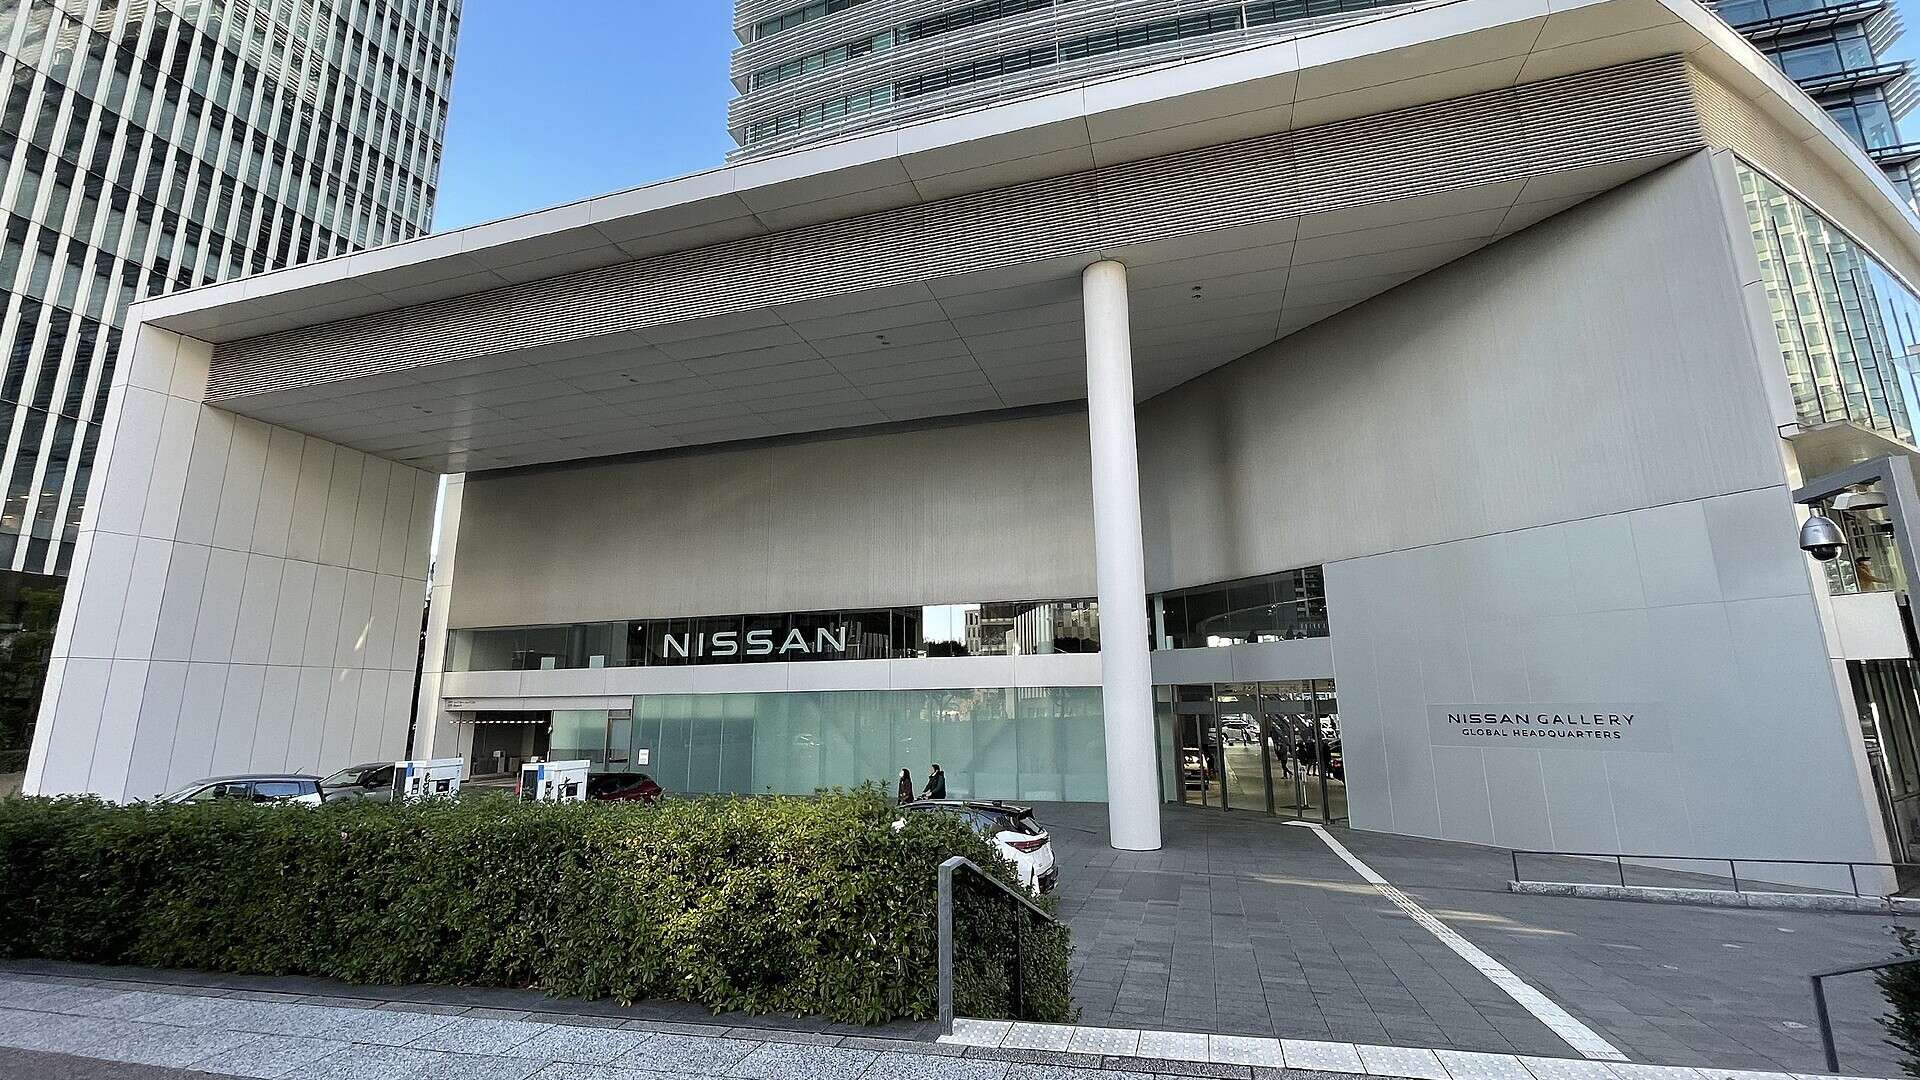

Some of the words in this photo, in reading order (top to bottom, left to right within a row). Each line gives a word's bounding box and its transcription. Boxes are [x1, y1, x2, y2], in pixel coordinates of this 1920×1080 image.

[663, 626, 846, 658] NISSAN
[1447, 713, 1530, 725] NISSAN
[1537, 714, 1635, 726] GALLERY
[1462, 728, 1508, 737] GLOBAL
[1513, 729, 1622, 739] HEADQUARTERS
